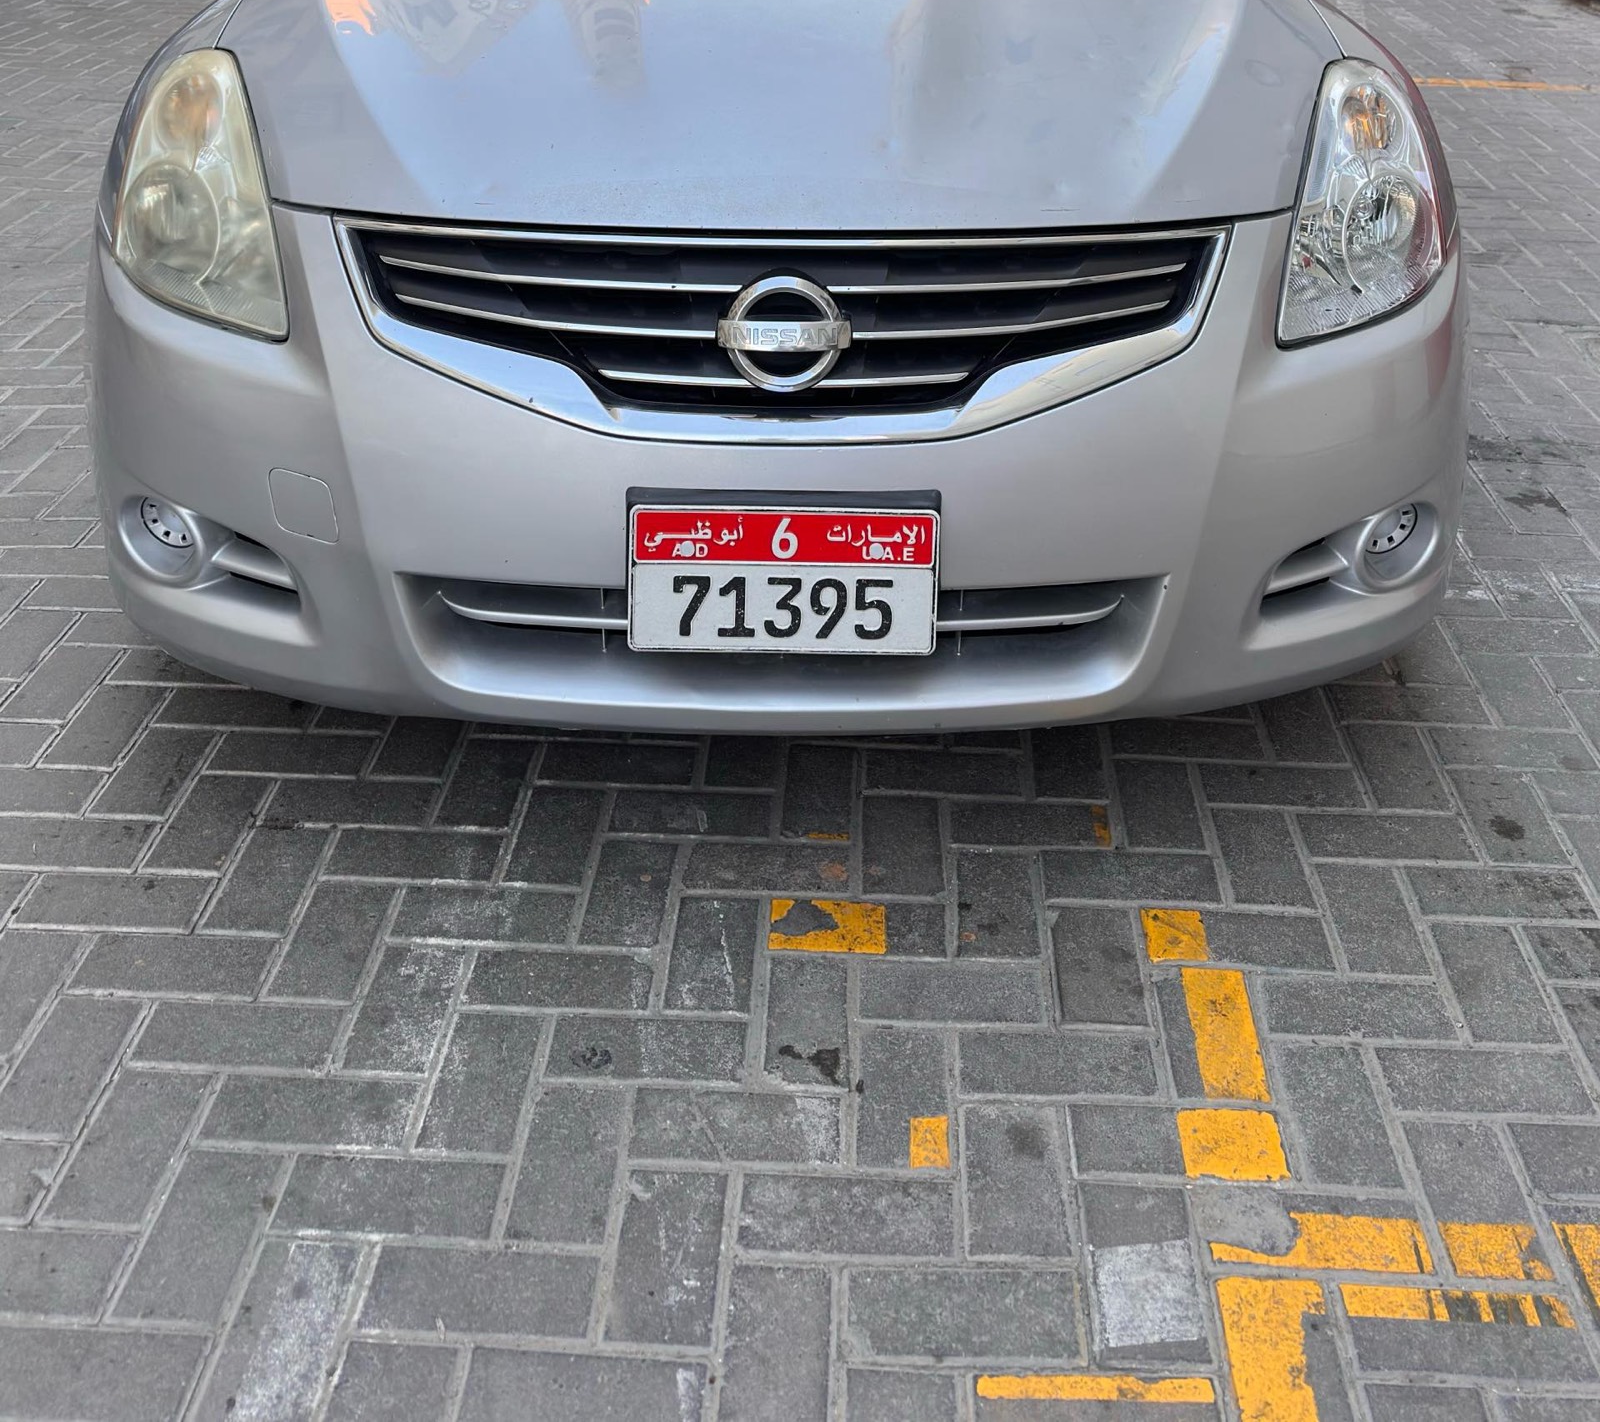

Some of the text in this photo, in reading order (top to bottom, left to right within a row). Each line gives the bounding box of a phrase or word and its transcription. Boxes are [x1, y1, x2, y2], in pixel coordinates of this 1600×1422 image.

[732, 326, 837, 346] NISSAN
[713, 515, 744, 547] أبو
[771, 516, 799, 560] 6
[671, 541, 709, 558] AD
[672, 574, 895, 640] 71395
